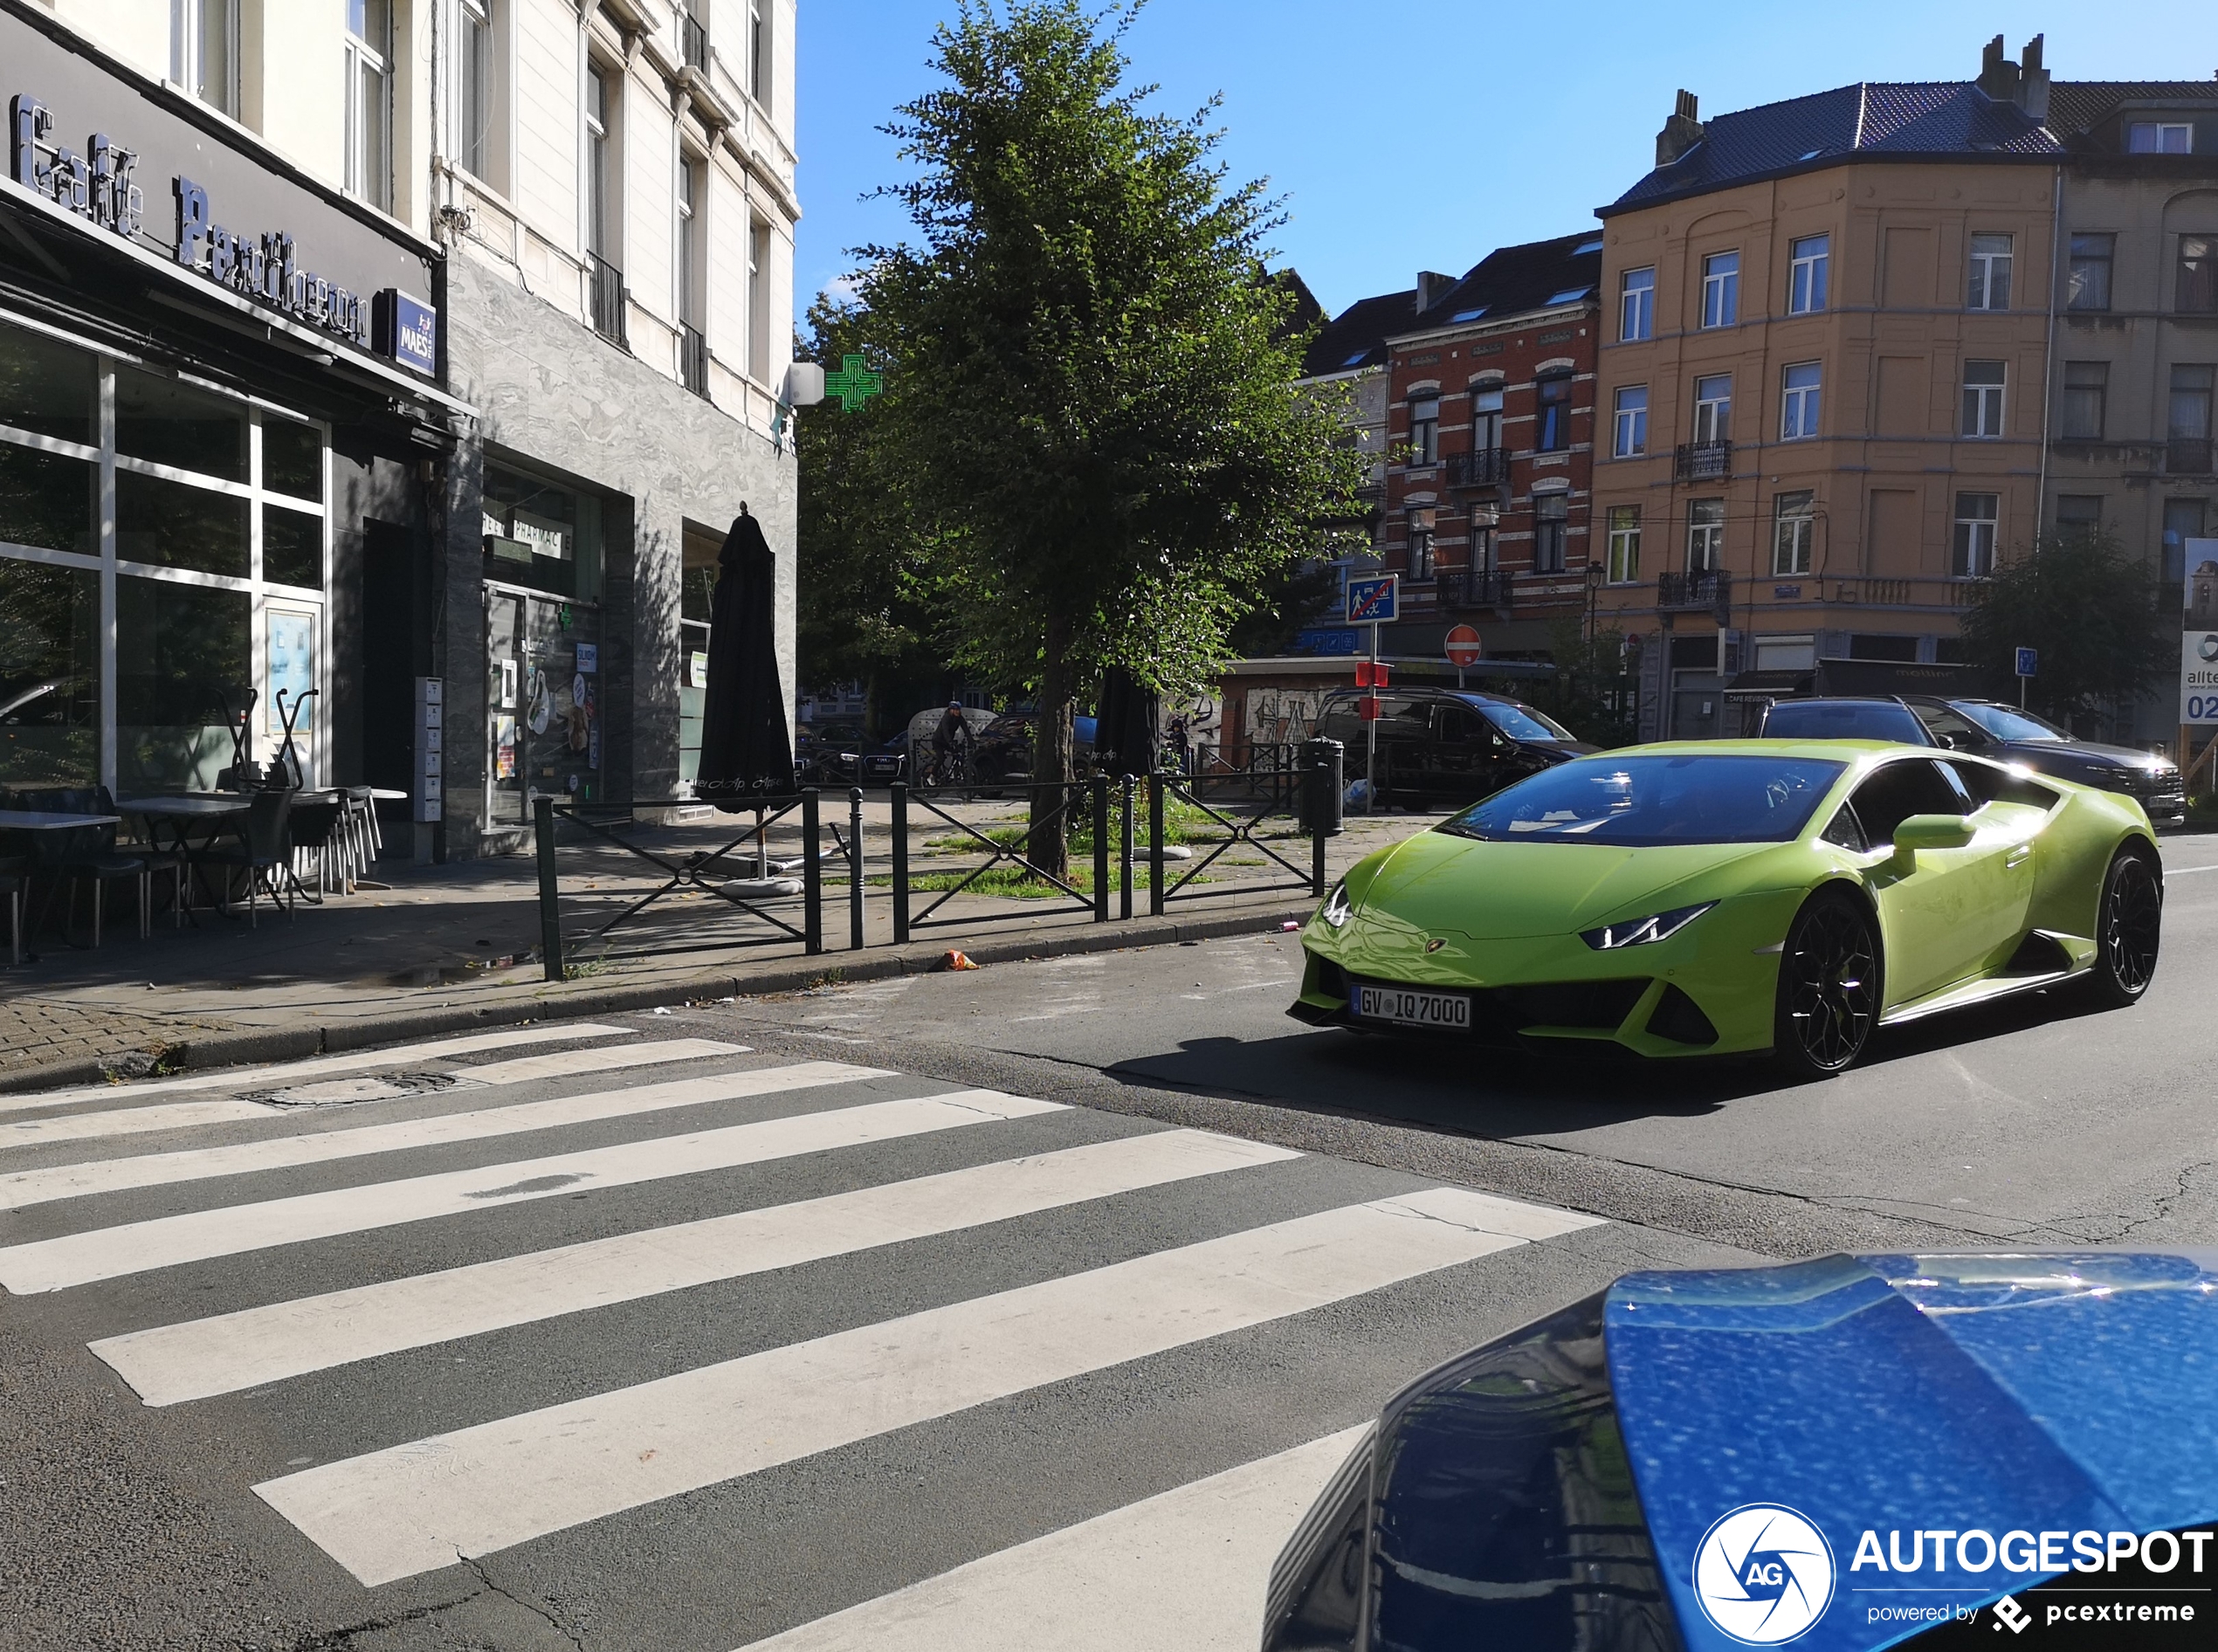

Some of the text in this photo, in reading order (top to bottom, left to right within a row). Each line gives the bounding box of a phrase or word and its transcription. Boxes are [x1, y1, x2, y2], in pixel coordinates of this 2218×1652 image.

[401, 326, 428, 358] MAES
[2187, 696, 2218, 719] 02
[1362, 989, 1466, 1024] GV IQ 7000
